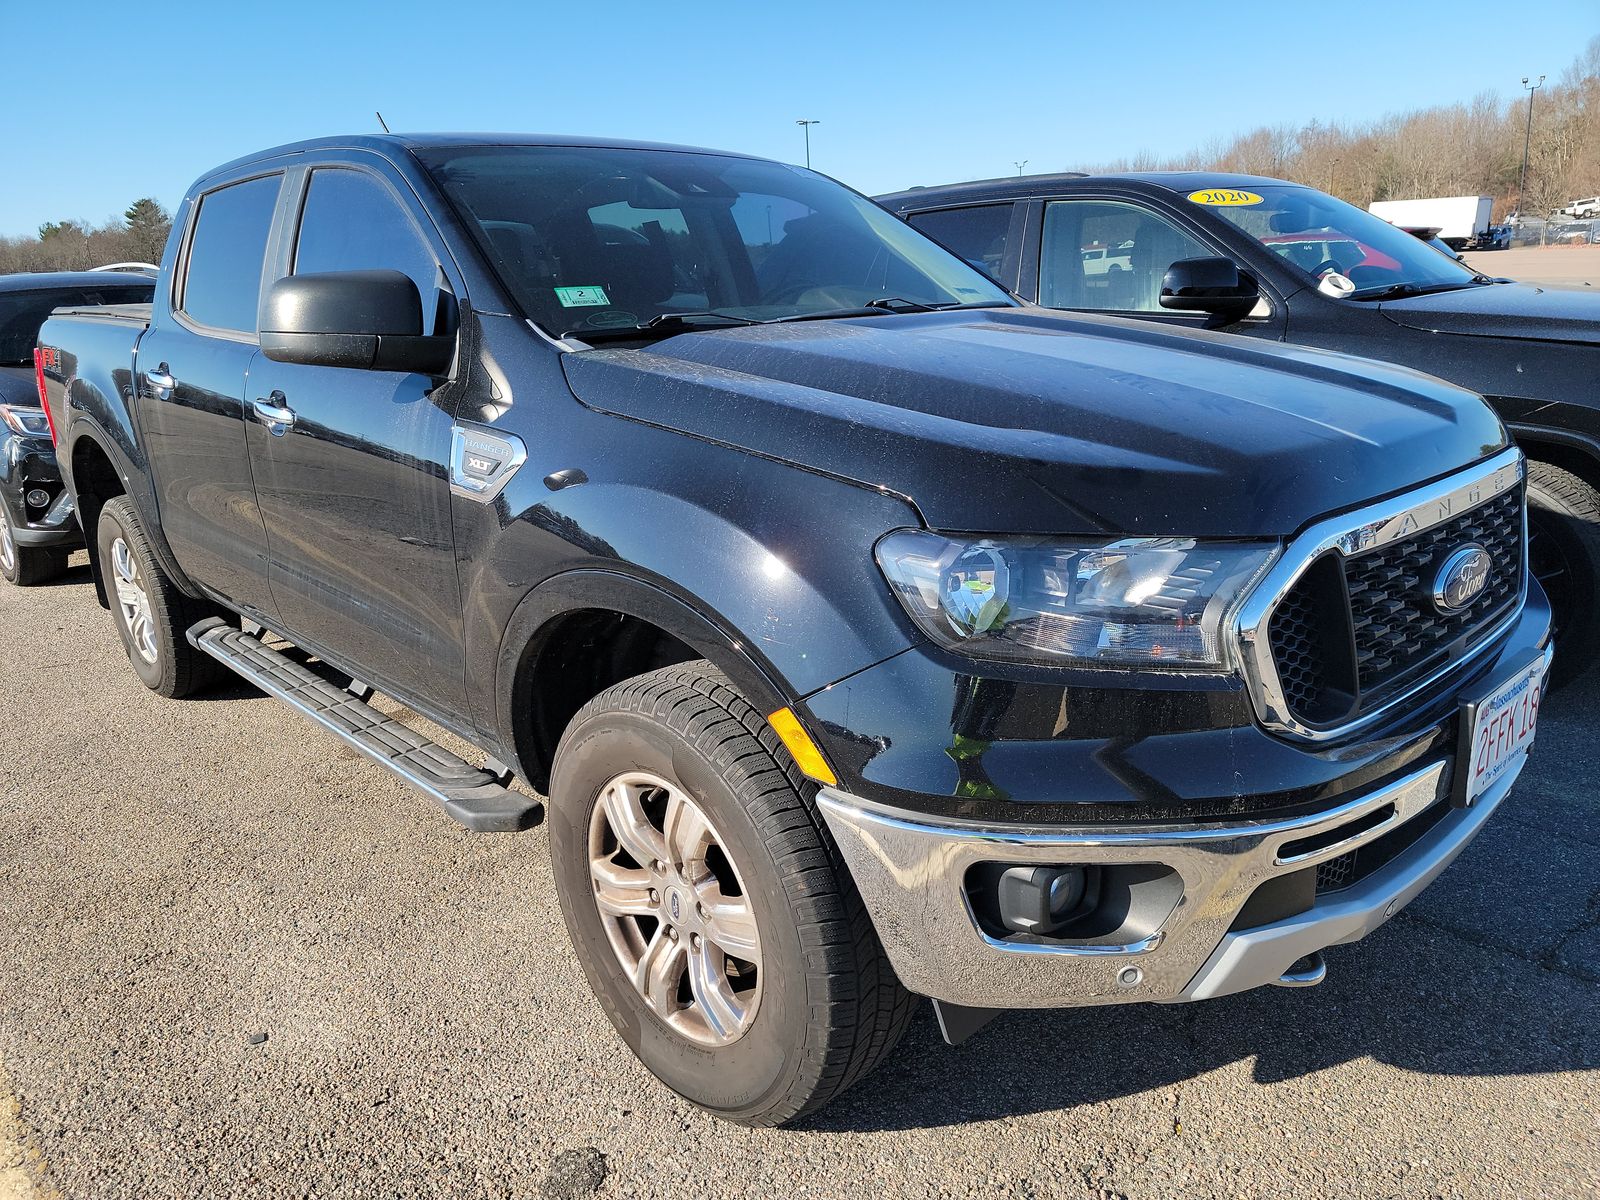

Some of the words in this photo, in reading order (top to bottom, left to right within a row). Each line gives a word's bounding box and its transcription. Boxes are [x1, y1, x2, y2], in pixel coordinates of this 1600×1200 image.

[1201, 191, 1250, 203] 2020
[41, 347, 62, 370] FX4
[465, 438, 510, 457] RANGER
[468, 457, 492, 471] XLT
[1458, 553, 1487, 601] Ford
[1475, 701, 1519, 778] 2FFK
[1517, 686, 1541, 741] 18
